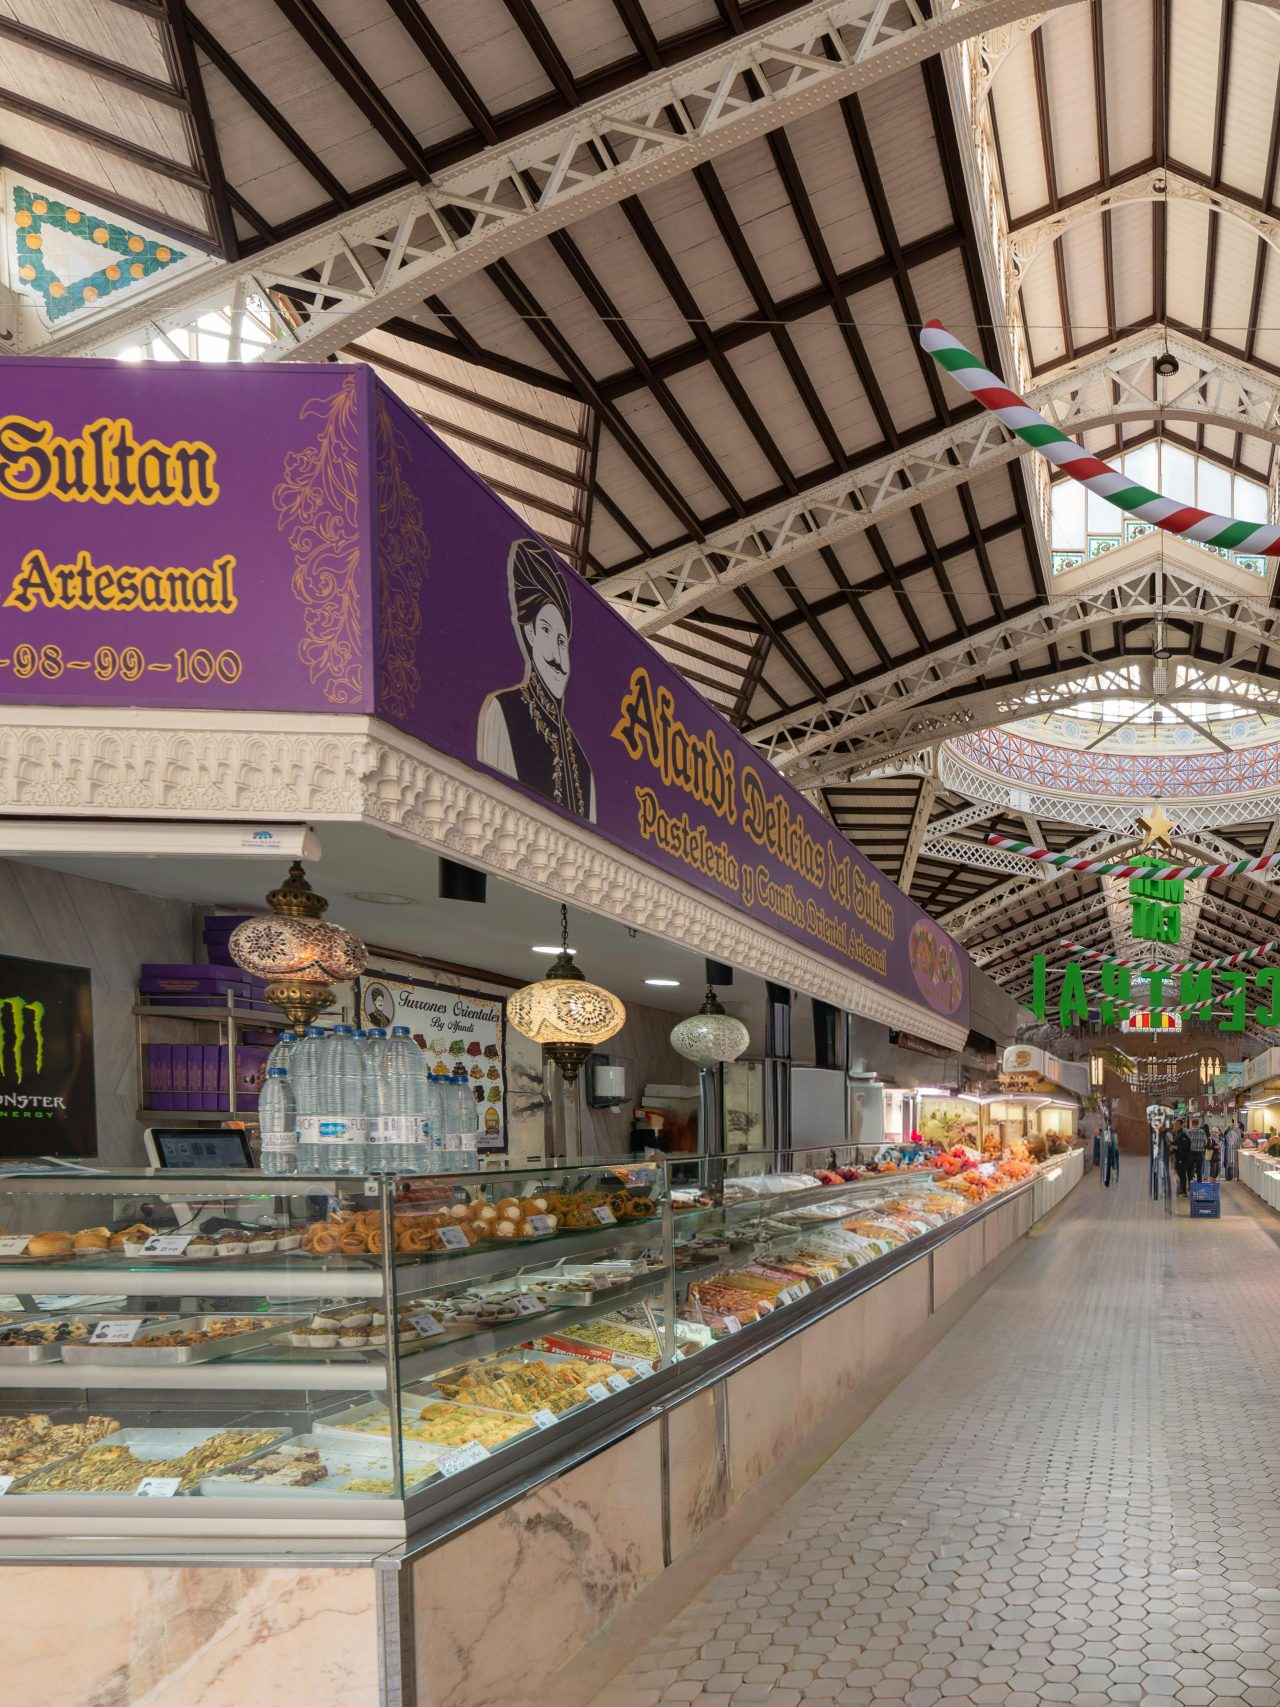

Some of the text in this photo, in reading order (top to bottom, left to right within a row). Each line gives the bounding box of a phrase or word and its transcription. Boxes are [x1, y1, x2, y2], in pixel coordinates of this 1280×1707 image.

[0, 415, 219, 506] Sultan
[2, 549, 238, 614] Artesanal
[611, 667, 895, 941] Afandi Delicias del Sultan
[742, 863, 754, 908] y
[756, 864, 806, 928] Comida
[807, 897, 847, 955] Oriental
[848, 928, 887, 977] Artesanal
[398, 990, 500, 1023] Turrones Orientales
[430, 1016, 475, 1034] By Afandi
[0, 1111, 54, 1119] NERGY
